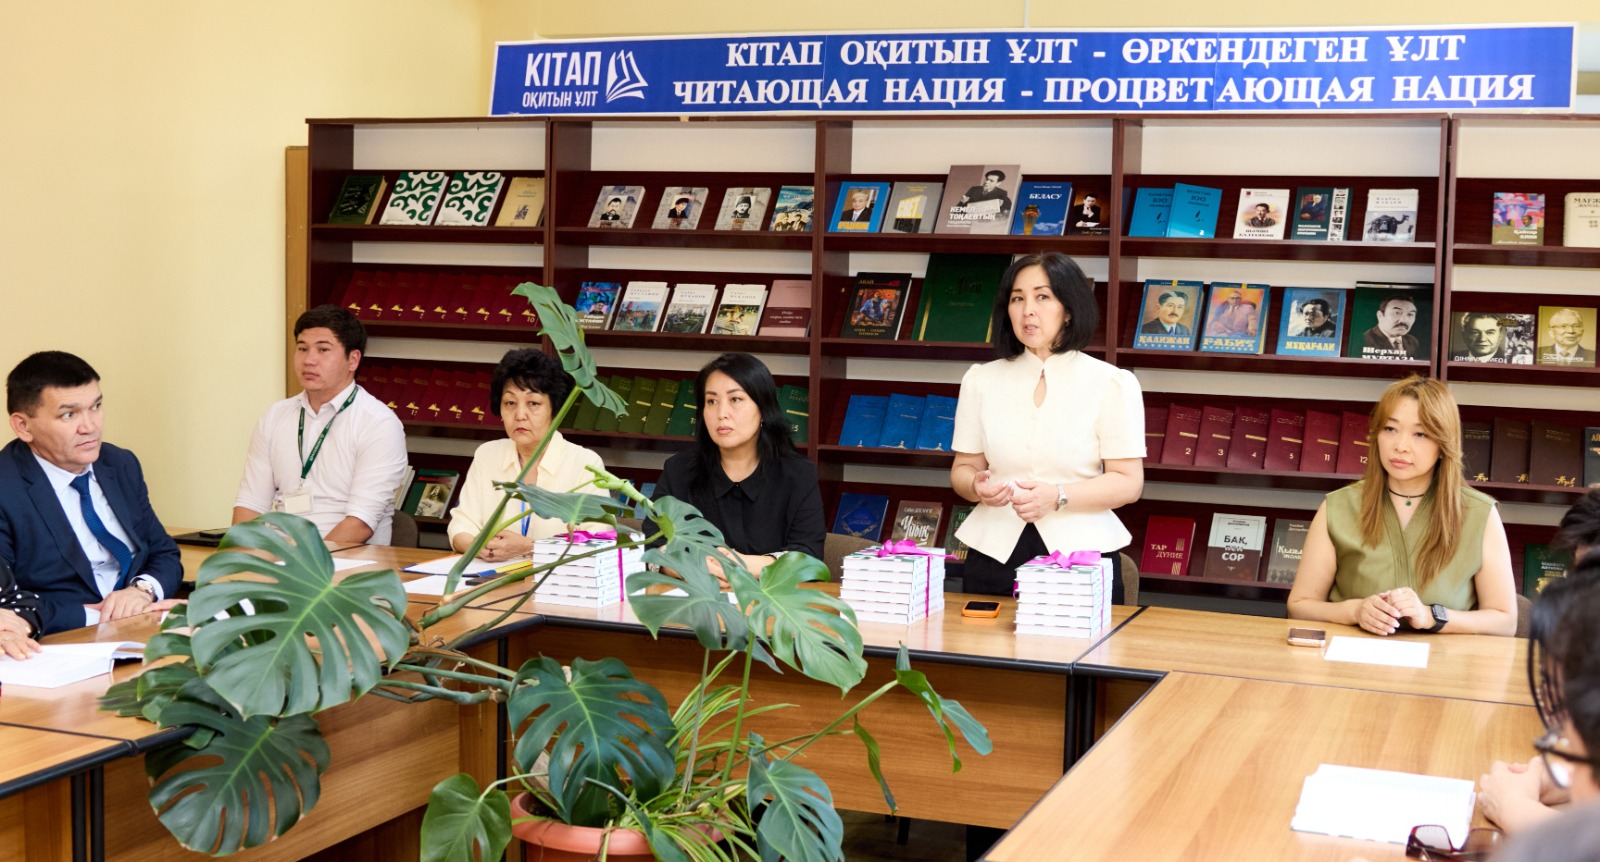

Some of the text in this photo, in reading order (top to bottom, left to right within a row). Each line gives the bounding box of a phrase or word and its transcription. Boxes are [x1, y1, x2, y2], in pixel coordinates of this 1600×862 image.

[726, 42, 823, 66] КІТАП
[841, 40, 990, 69] ОҚИТЫН
[1006, 39, 1077, 64] ҰЛТ
[1122, 36, 1368, 69] ӨРКЕНДЕГЕН
[1386, 35, 1466, 62] ҰЛТ
[525, 52, 602, 87] КІТАП
[673, 79, 868, 108] ЧИТАЮЩАЯ
[882, 78, 1005, 108] НАЦИЯ
[1392, 74, 1535, 106] НАЦИЯ
[522, 90, 599, 108] ОҚИТЫН ҰЛТ
[1362, 346, 1407, 355] Шерхан
[1185, 447, 1192, 455] 2
[1217, 448, 1224, 456] 3
[1288, 452, 1295, 460] 5
[1359, 455, 1369, 464] 12
[1150, 543, 1168, 551] ТАР
[1221, 552, 1245, 562] СОР
